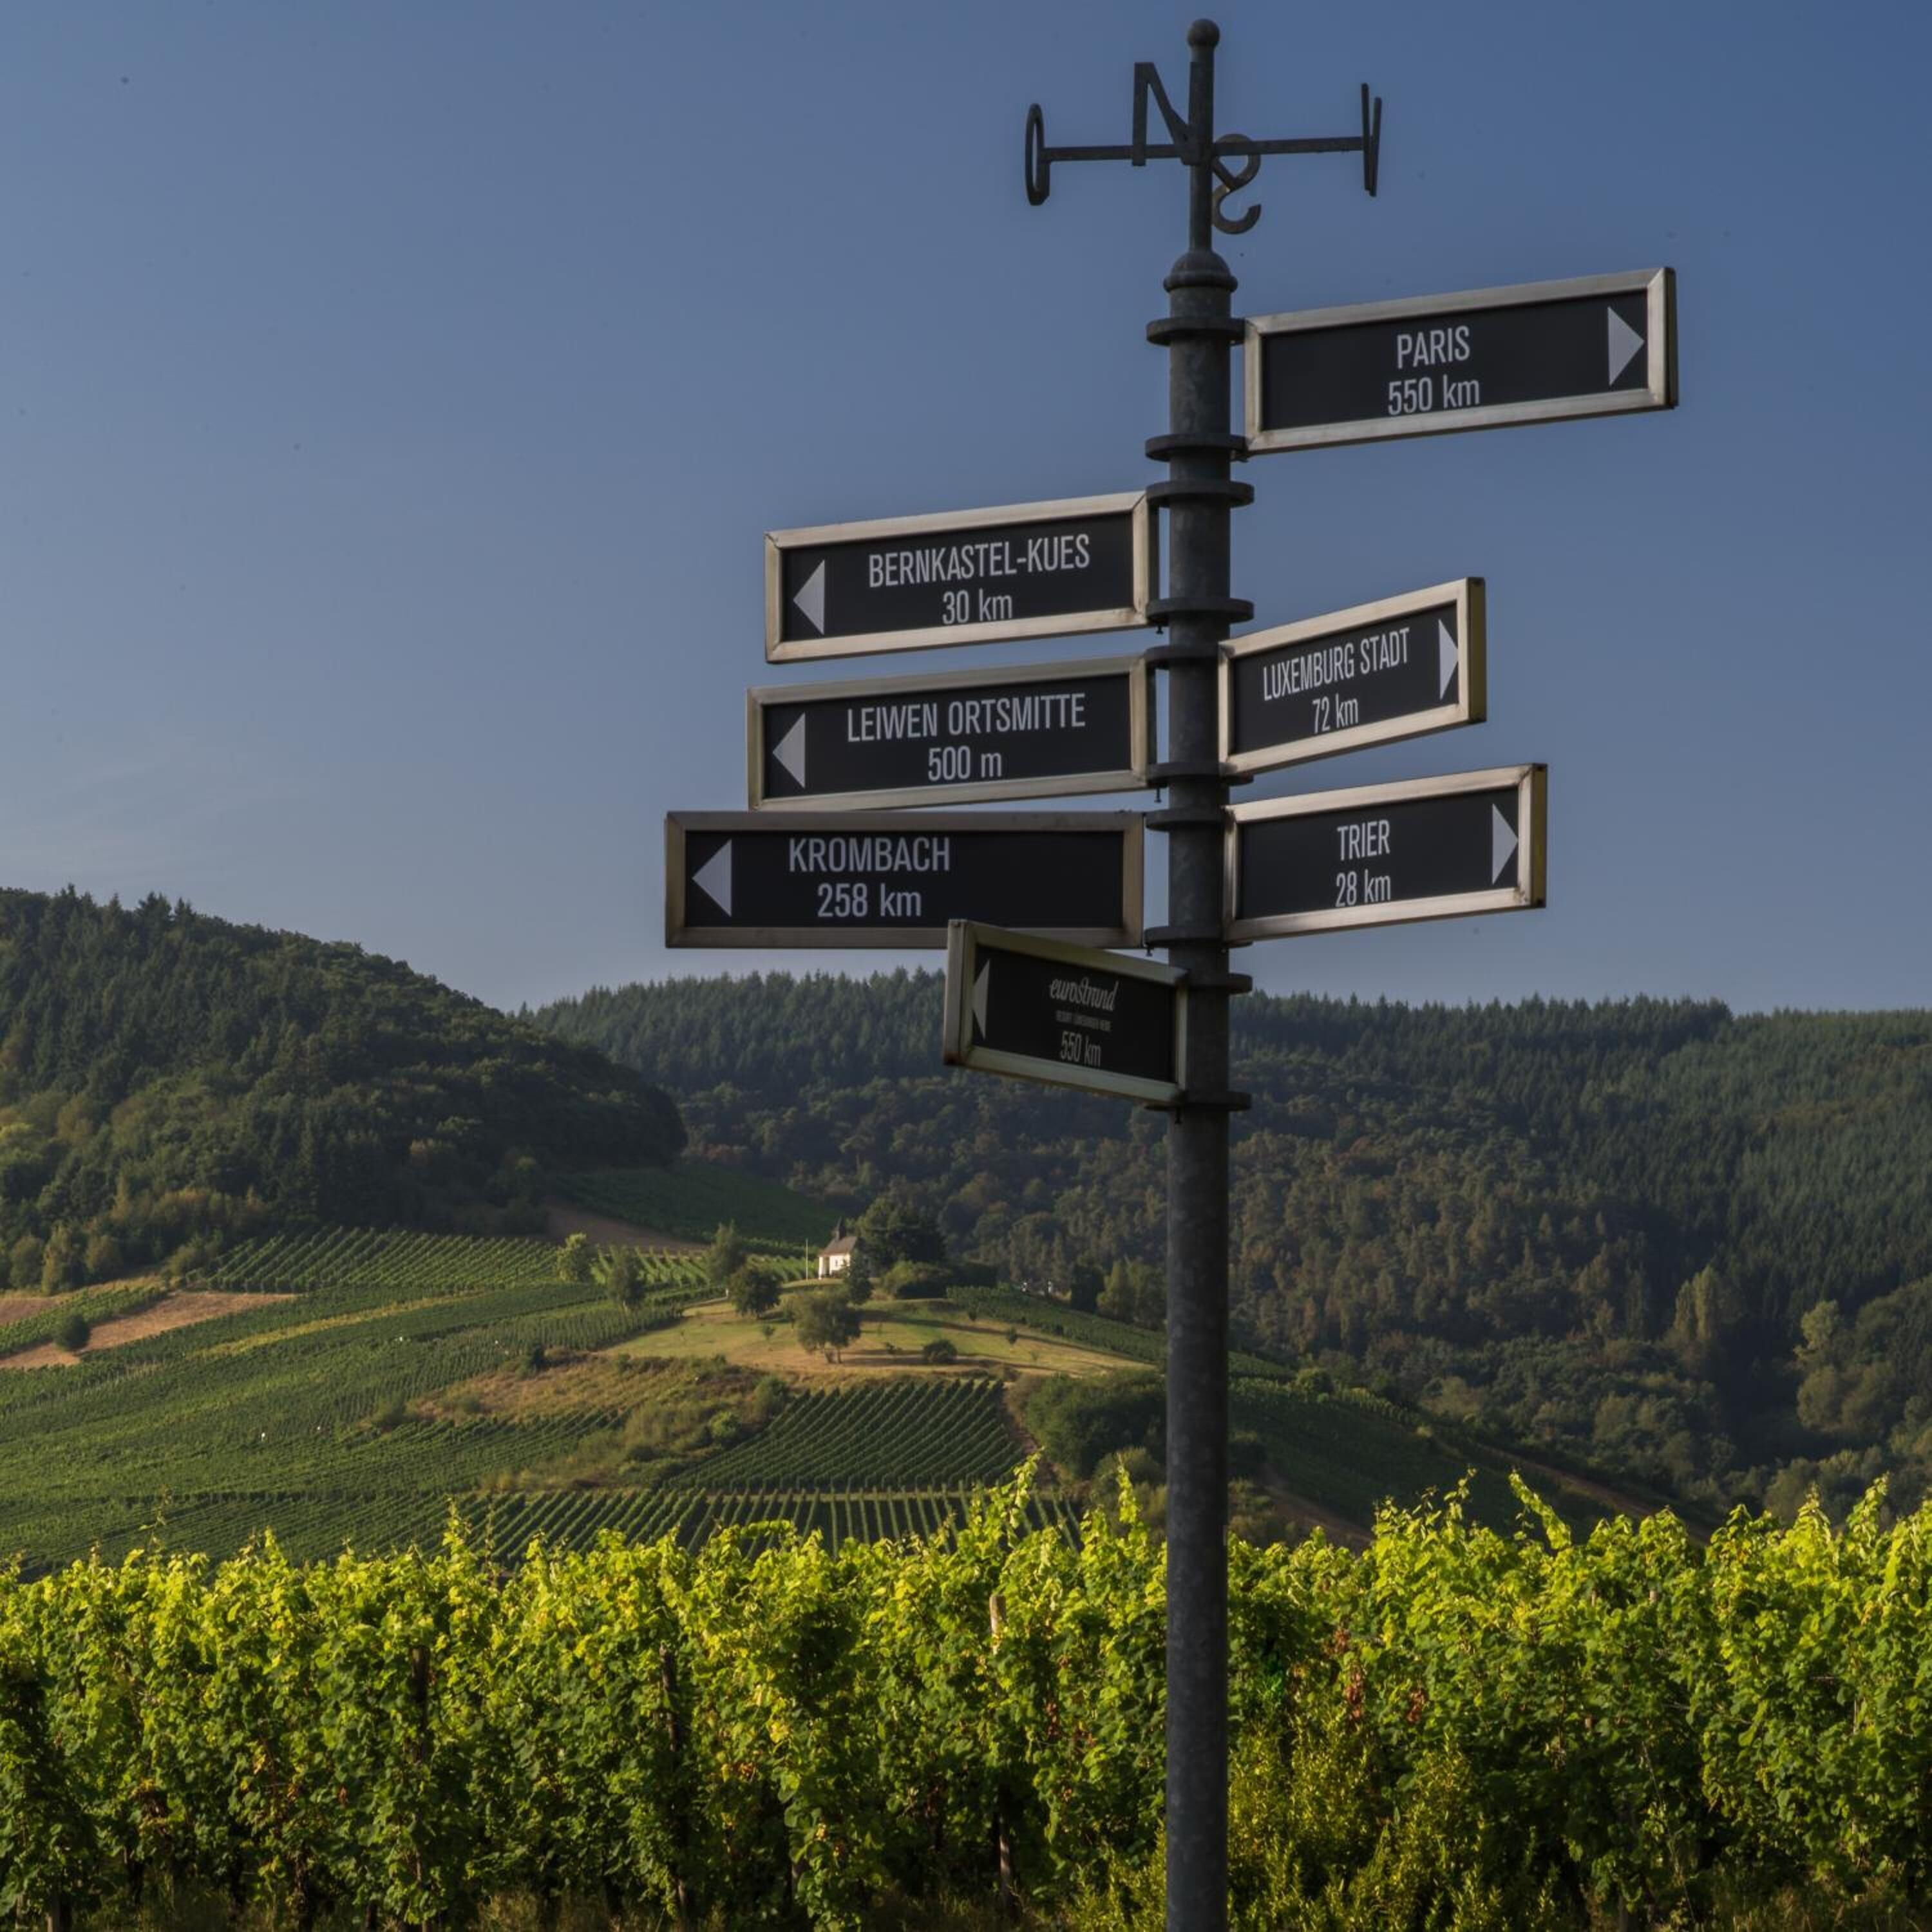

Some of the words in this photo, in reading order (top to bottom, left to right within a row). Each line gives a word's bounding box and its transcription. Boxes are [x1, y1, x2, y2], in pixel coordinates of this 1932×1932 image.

[1397, 325, 1470, 369] PARIS
[1388, 377, 1433, 416] 550
[1443, 374, 1480, 409] km
[869, 534, 1090, 588] BERNKASTEL-KUES
[942, 590, 969, 625] 30
[978, 588, 1013, 622] km
[1263, 643, 1354, 701] LUXEMBURG
[1360, 627, 1410, 674] STADT
[848, 703, 937, 742] LEIWEN
[948, 693, 1086, 735] ORTSMITTE
[1312, 696, 1331, 734] 72
[1335, 693, 1358, 728] km
[928, 746, 971, 781] 500
[981, 752, 1002, 778] m
[789, 837, 950, 872] KROMBACH
[1336, 819, 1390, 861] TRIER
[817, 882, 868, 917] 258
[880, 883, 922, 917] km
[1335, 871, 1357, 907] 28
[1364, 869, 1391, 904] km
[1050, 977, 1119, 1010] eurostrand
[1060, 1030, 1082, 1062] 550
[1084, 1035, 1101, 1067] km
